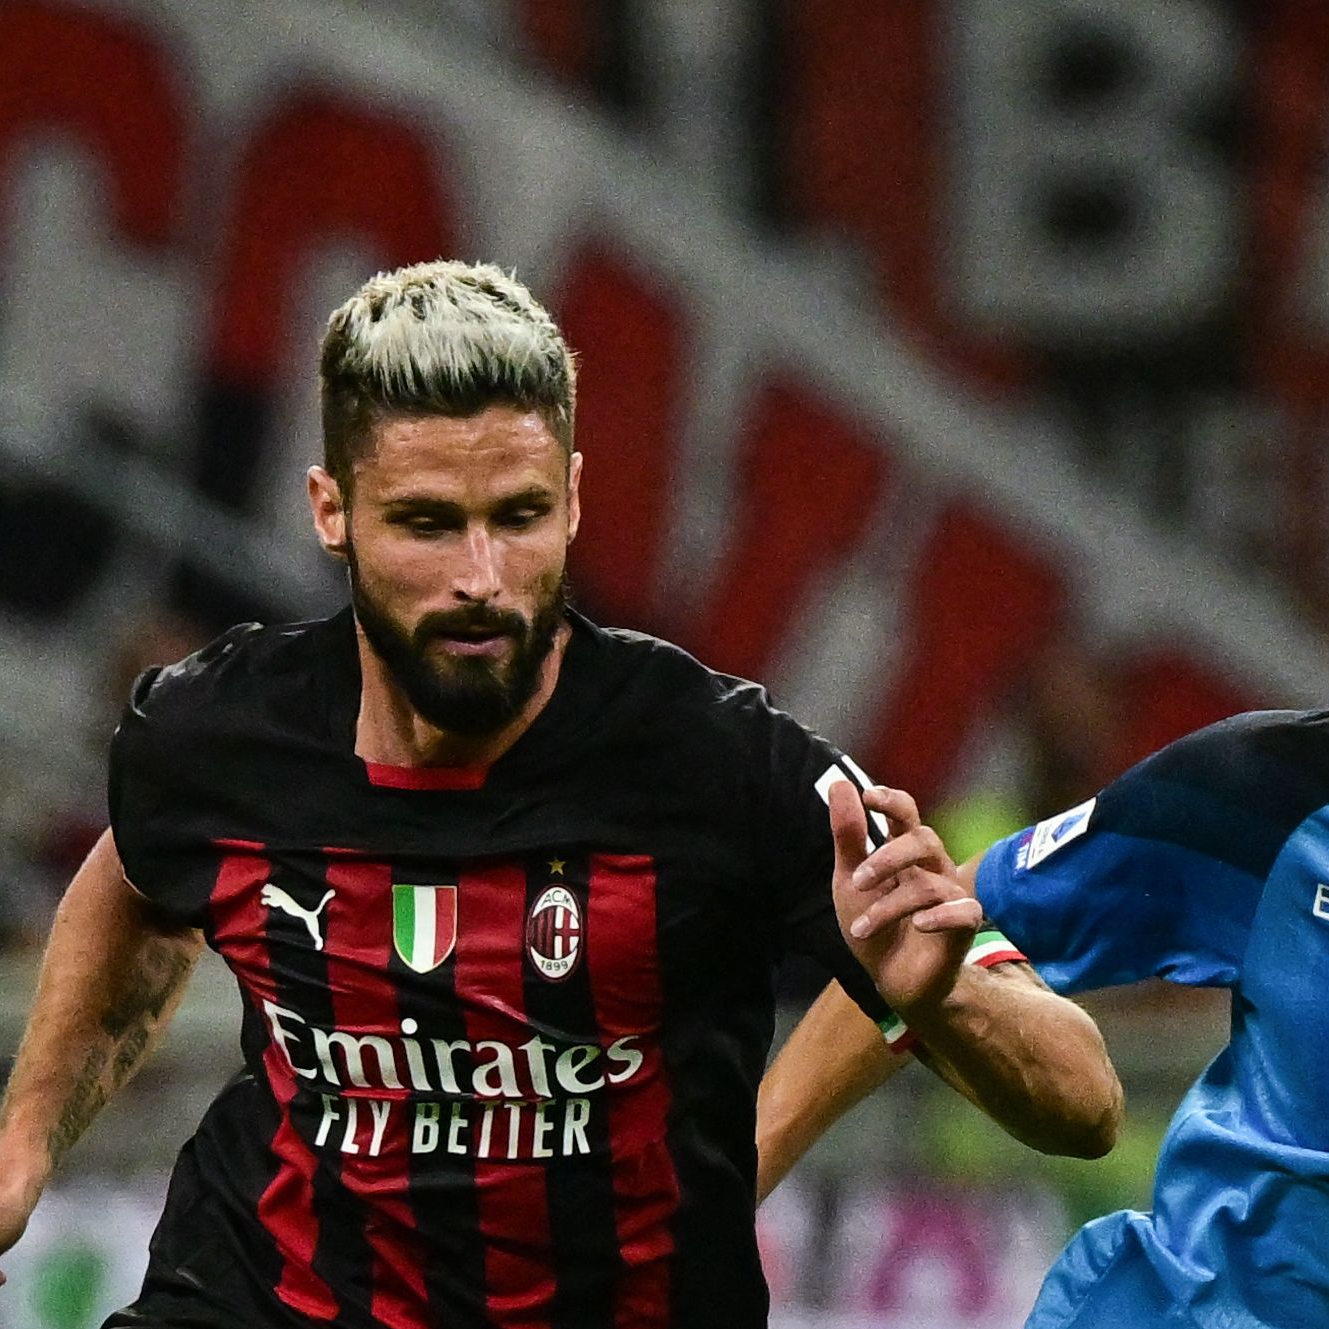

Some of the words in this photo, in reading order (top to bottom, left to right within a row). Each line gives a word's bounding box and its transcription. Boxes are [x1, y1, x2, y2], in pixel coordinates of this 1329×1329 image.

[540, 960, 569, 971] 1899
[263, 999, 644, 1098] Emirates
[314, 1094, 391, 1157] FLY
[412, 1099, 591, 1159] BETTER
